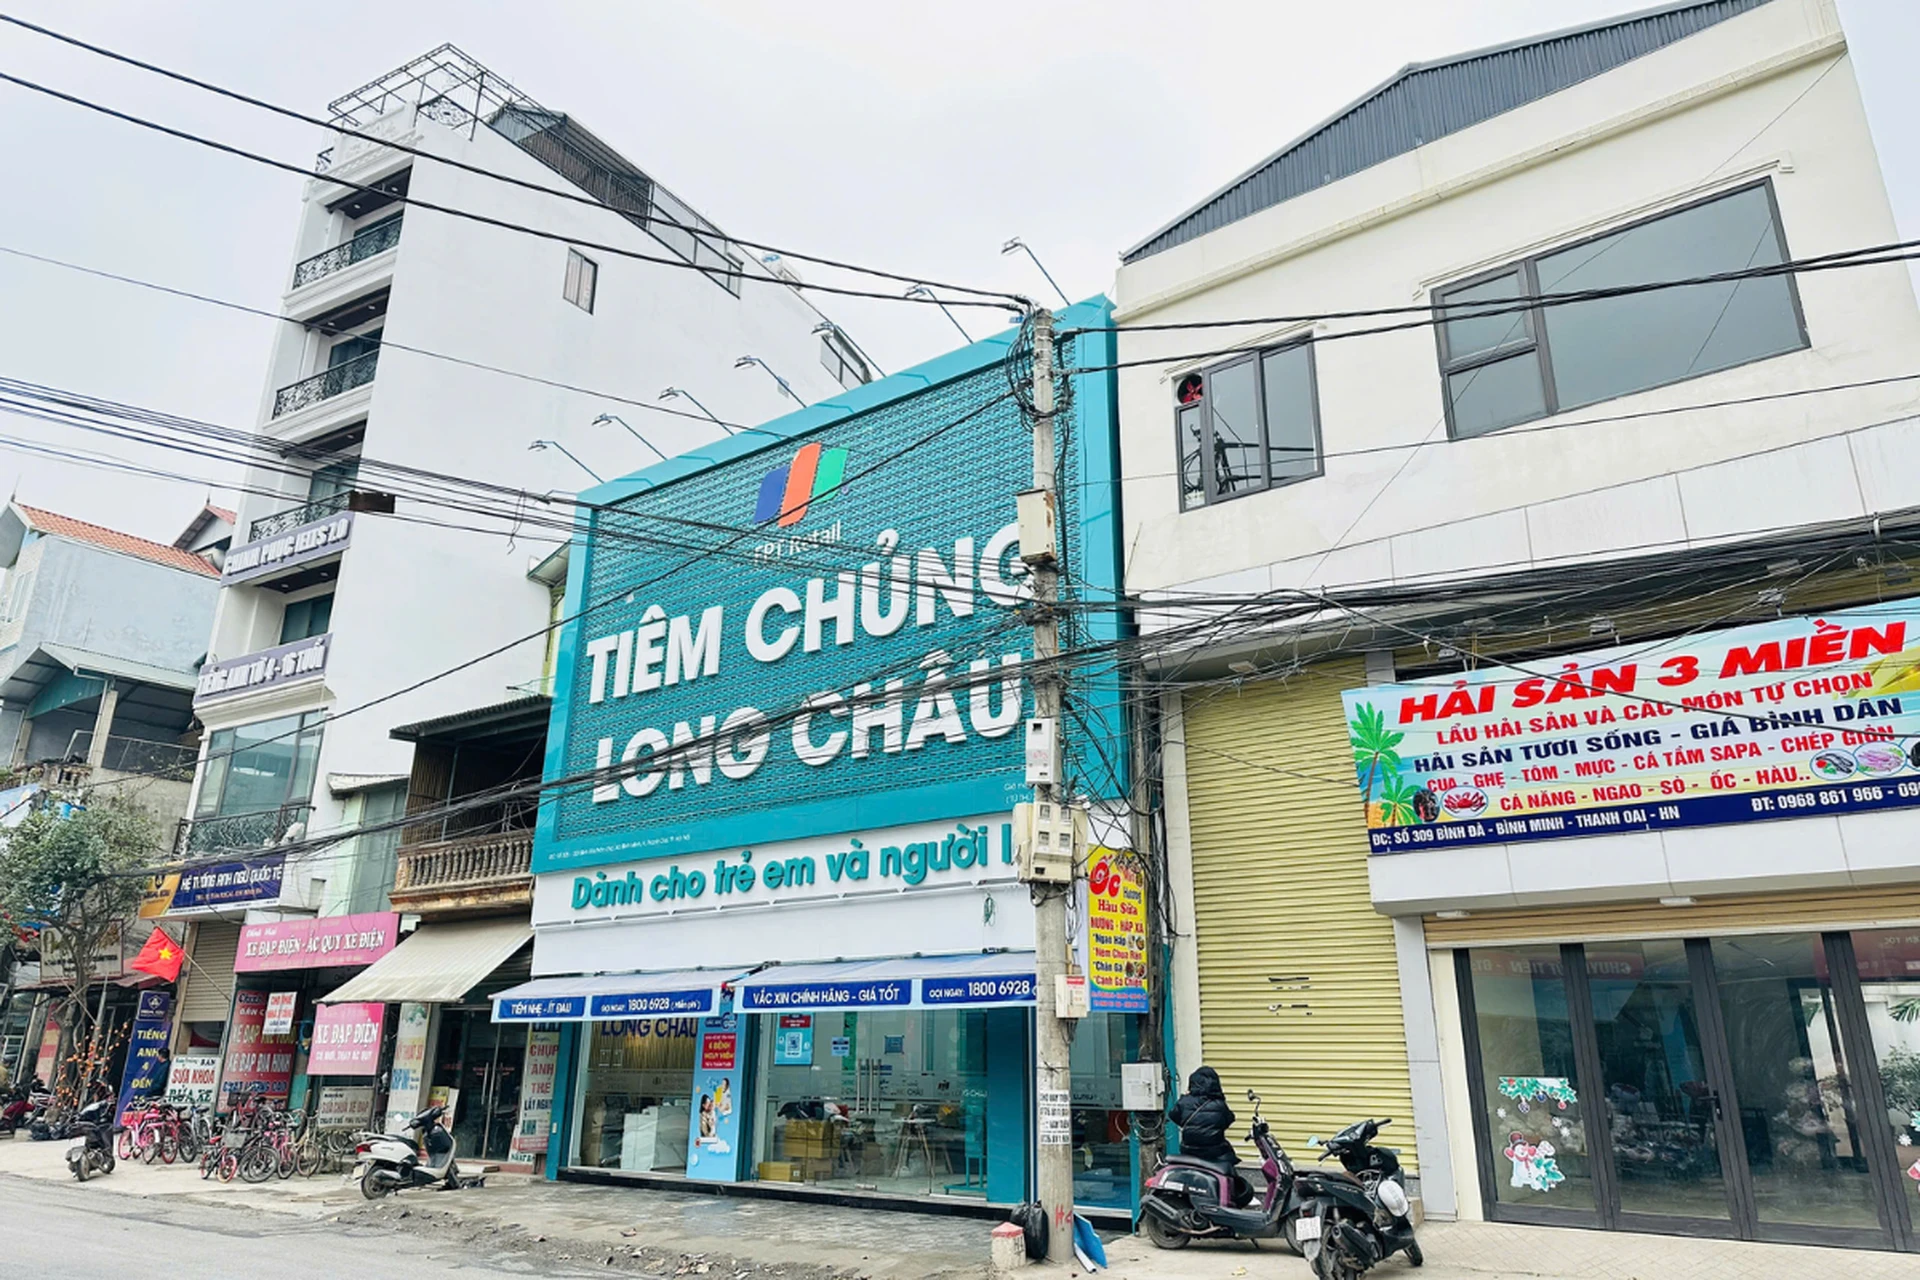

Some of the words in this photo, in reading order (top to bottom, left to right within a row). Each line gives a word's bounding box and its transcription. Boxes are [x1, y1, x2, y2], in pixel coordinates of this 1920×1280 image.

[586, 605, 723, 704] TIÊM
[1398, 679, 1496, 725] HẢI
[1511, 662, 1638, 708] SẢN
[1656, 655, 1699, 687] 3
[1718, 618, 1907, 680] MIỀN
[592, 706, 771, 804] LONG
[790, 648, 1023, 767] CHÂU
[1483, 717, 1523, 739] HẢI
[1529, 711, 1579, 734] SẢN
[1583, 704, 1617, 726] VÀ
[1681, 691, 1744, 714] MÓN
[1750, 682, 1786, 705] TỰ
[1792, 671, 1873, 696] CHỌN
[1414, 751, 1455, 774] HẢI
[1462, 745, 1513, 769] SẢN
[1519, 739, 1579, 762] TƯƠI
[1586, 728, 1662, 754] SỐNG
[1690, 716, 1741, 741] GIÁ
[1749, 708, 1825, 734] BÌNH
[1832, 697, 1903, 723] DÂN
[1426, 777, 1458, 794] CUA
[1474, 771, 1506, 789] GHẸ
[1520, 765, 1559, 784] TÔM
[1575, 758, 1616, 779] MỰC
[1633, 750, 1660, 772] CÁ
[1710, 741, 1763, 763] SAPA
[1780, 731, 1836, 754] CHÉP
[1500, 793, 1524, 812] CÁ
[1593, 781, 1642, 802] NGAO
[1660, 775, 1686, 795] SÒ
[1710, 769, 1737, 790] ỐC
[1751, 797, 1775, 812] ĐT:
[1777, 793, 1816, 809] 0968
[1819, 789, 1848, 806] 861
[1853, 785, 1884, 802] 966
[1371, 832, 1392, 847] ĐC:
[1394, 825, 1410, 845] SỐ
[1412, 828, 1434, 843] 309
[1437, 823, 1467, 842] BÌNH
[1468, 822, 1486, 838] ĐÀ
[1496, 818, 1527, 836] BÌNH
[1529, 816, 1565, 832] MINH
[1574, 809, 1621, 829] THANH
[1622, 808, 1647, 825] OAI
[1659, 805, 1681, 820] HN
[571, 867, 643, 910] Dành
[649, 863, 706, 900] cho
[713, 849, 756, 895] trẻ
[761, 854, 816, 888] em
[825, 837, 870, 882] và
[879, 822, 988, 886] người
[321, 934, 344, 955] QUY
[344, 932, 359, 951] XE
[359, 927, 387, 951] ĐIỆN
[628, 999, 649, 1011] 1800
[649, 997, 670, 1009] 6928
[773, 990, 790, 1004] XIN
[858, 985, 877, 1002] GIÁ
[878, 982, 901, 1001] TỐT
[967, 981, 997, 996] 1800
[998, 979, 1030, 996] 6928
[137, 1028, 168, 1040] TIẾNG
[137, 1047, 159, 1058] ANH
[529, 1043, 560, 1060] CHỤP
